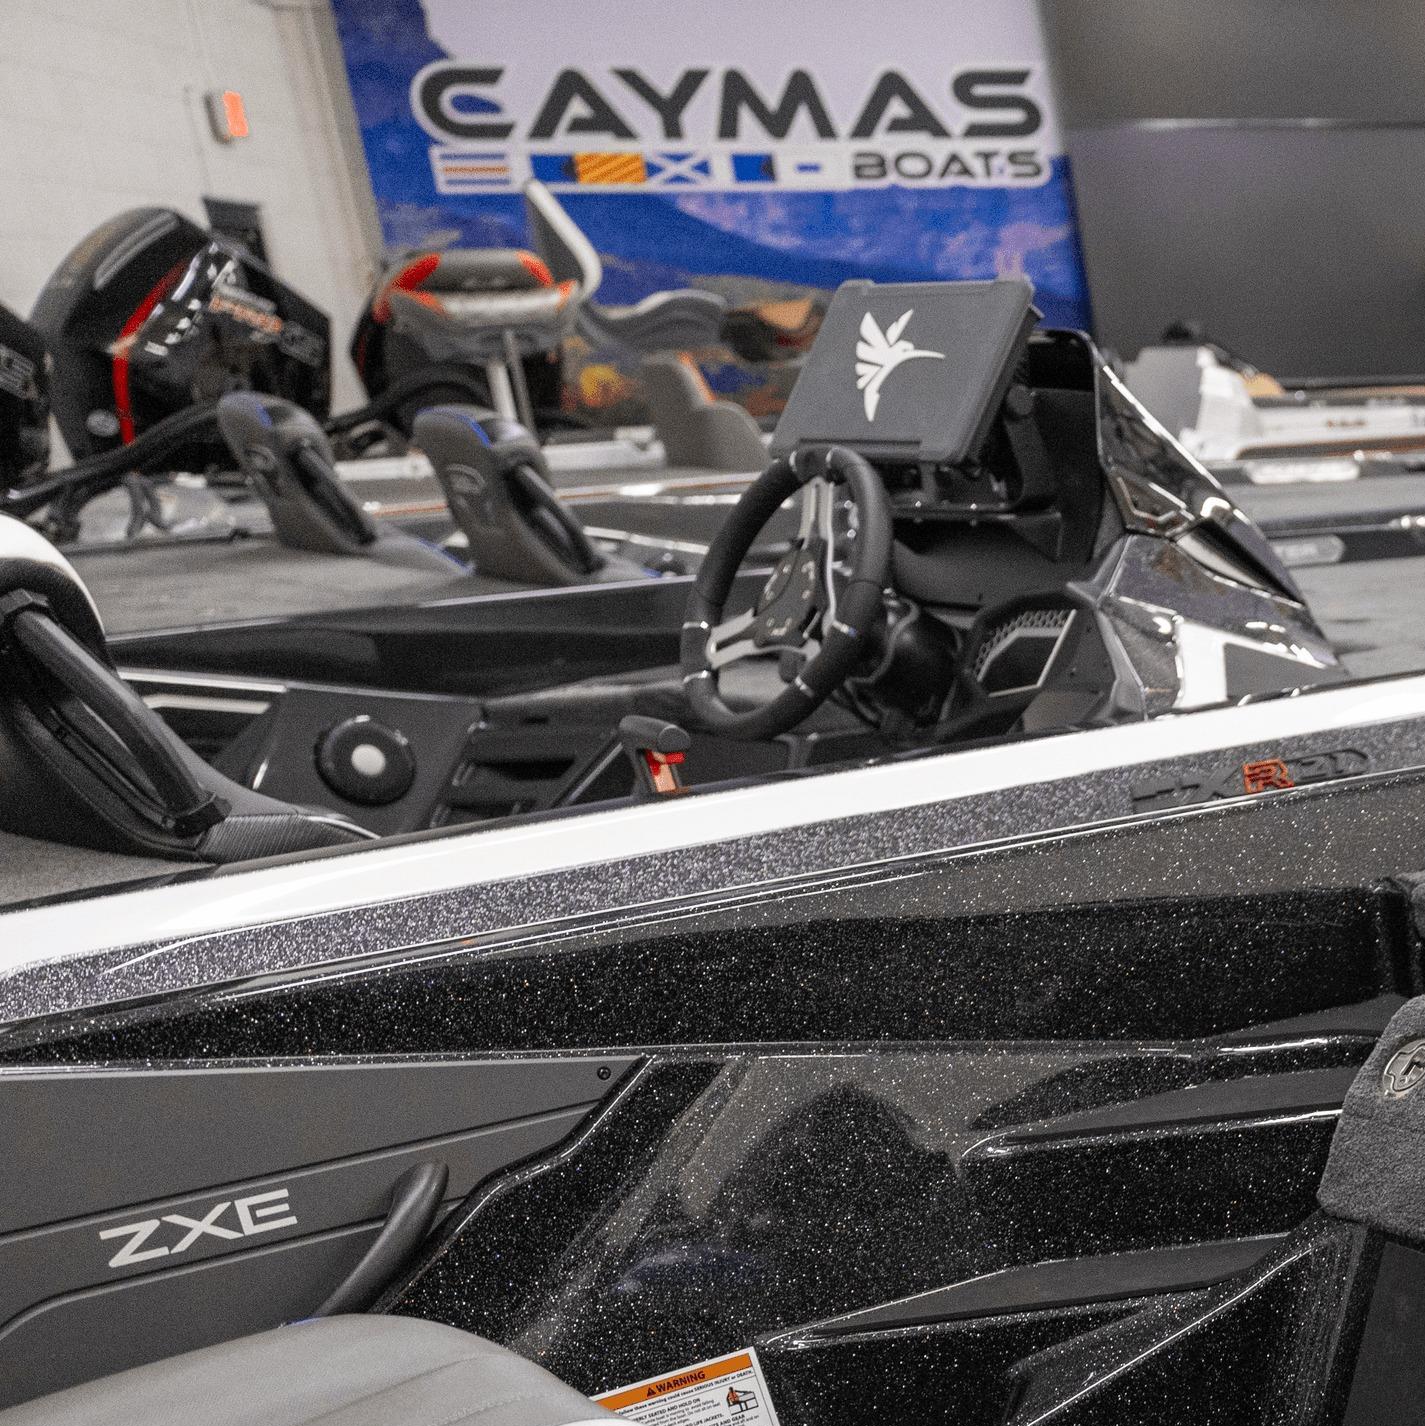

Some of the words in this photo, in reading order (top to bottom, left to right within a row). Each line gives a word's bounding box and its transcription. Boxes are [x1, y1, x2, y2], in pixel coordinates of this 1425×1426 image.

[418, 67, 1042, 139] CAYMAS
[853, 150, 1042, 179] BOATS
[99, 1188, 298, 1268] ZXE
[647, 1397, 666, 1406] warning
[693, 1382, 713, 1391] SERIOUS
[714, 1376, 730, 1384] INJURY
[655, 1370, 706, 1393] WARNING
[648, 1408, 666, 1417] SEATED
[678, 1400, 692, 1408] HOLD
[731, 1413, 744, 1421] GEAR
